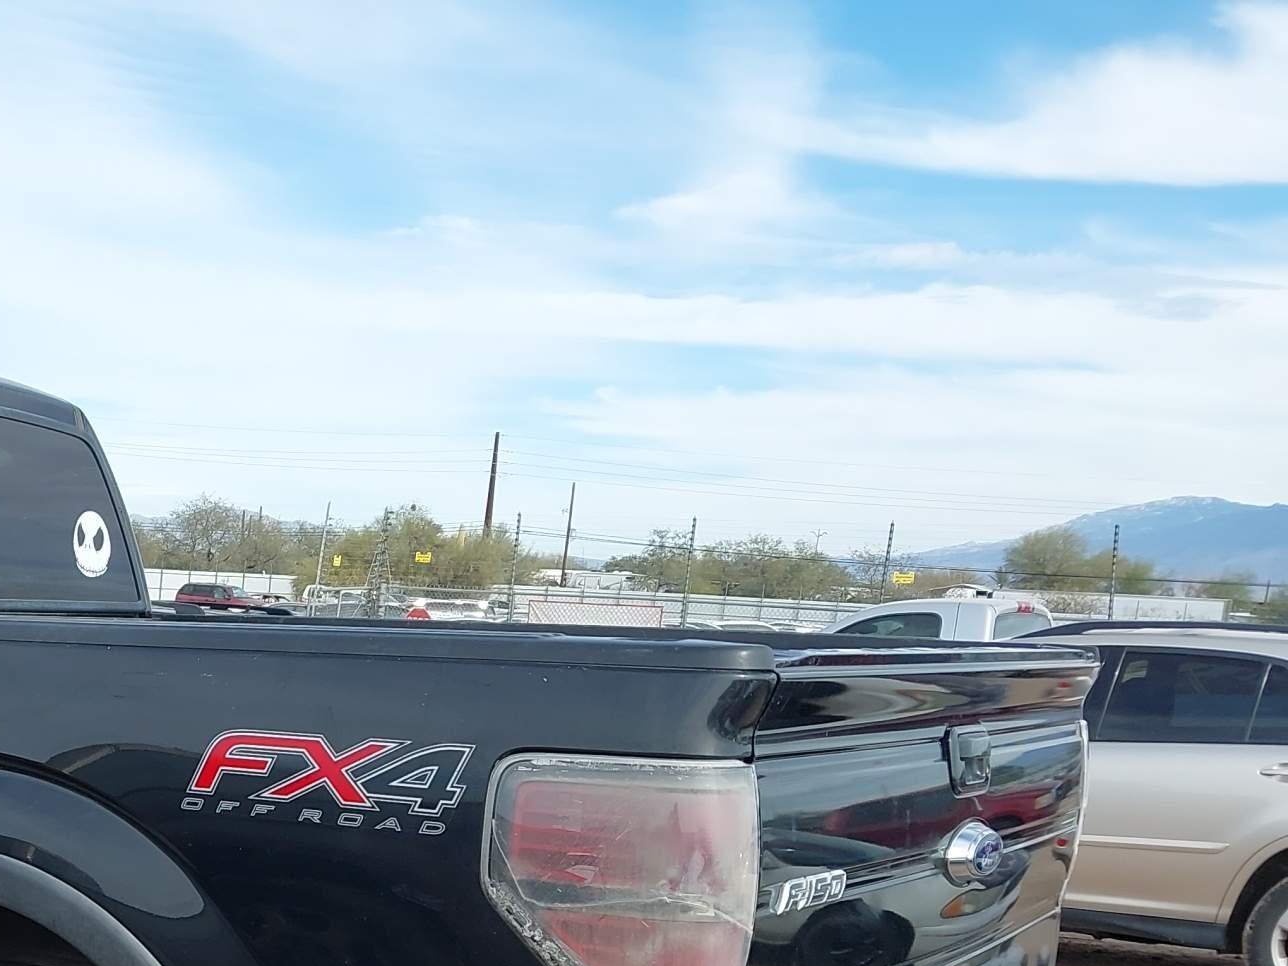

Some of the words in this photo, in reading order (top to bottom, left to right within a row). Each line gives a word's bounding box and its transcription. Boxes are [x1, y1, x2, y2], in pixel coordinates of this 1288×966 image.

[186, 729, 476, 816] FX4
[180, 797, 276, 817] OFF
[298, 809, 446, 836] ROAD
